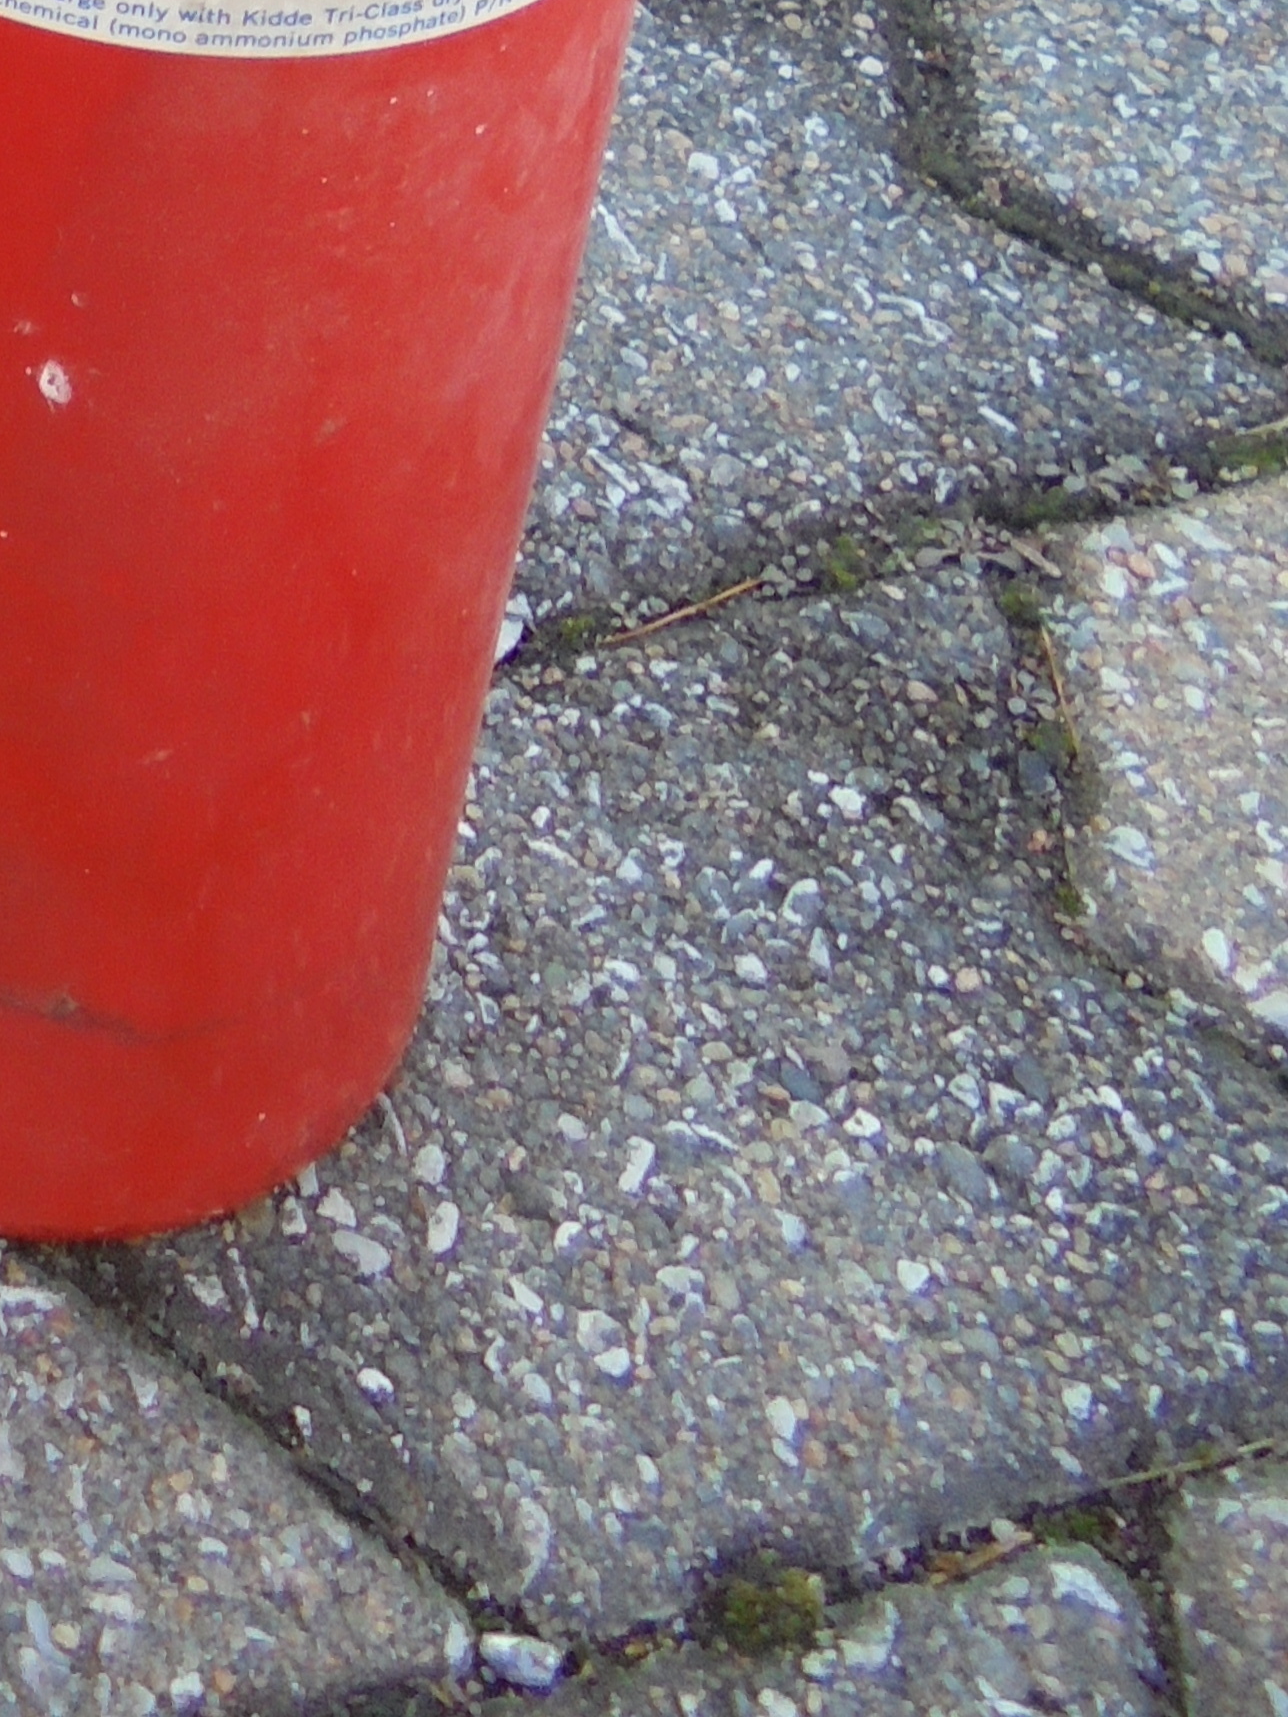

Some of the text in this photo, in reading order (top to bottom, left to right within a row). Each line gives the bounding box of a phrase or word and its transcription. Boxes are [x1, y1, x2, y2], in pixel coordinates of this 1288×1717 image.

[109, 16, 187, 45] (mono
[194, 31, 334, 49] ammonium
[343, 0, 465, 46] phosphate)
[178, 5, 231, 26] with
[243, 9, 313, 27] Kidde
